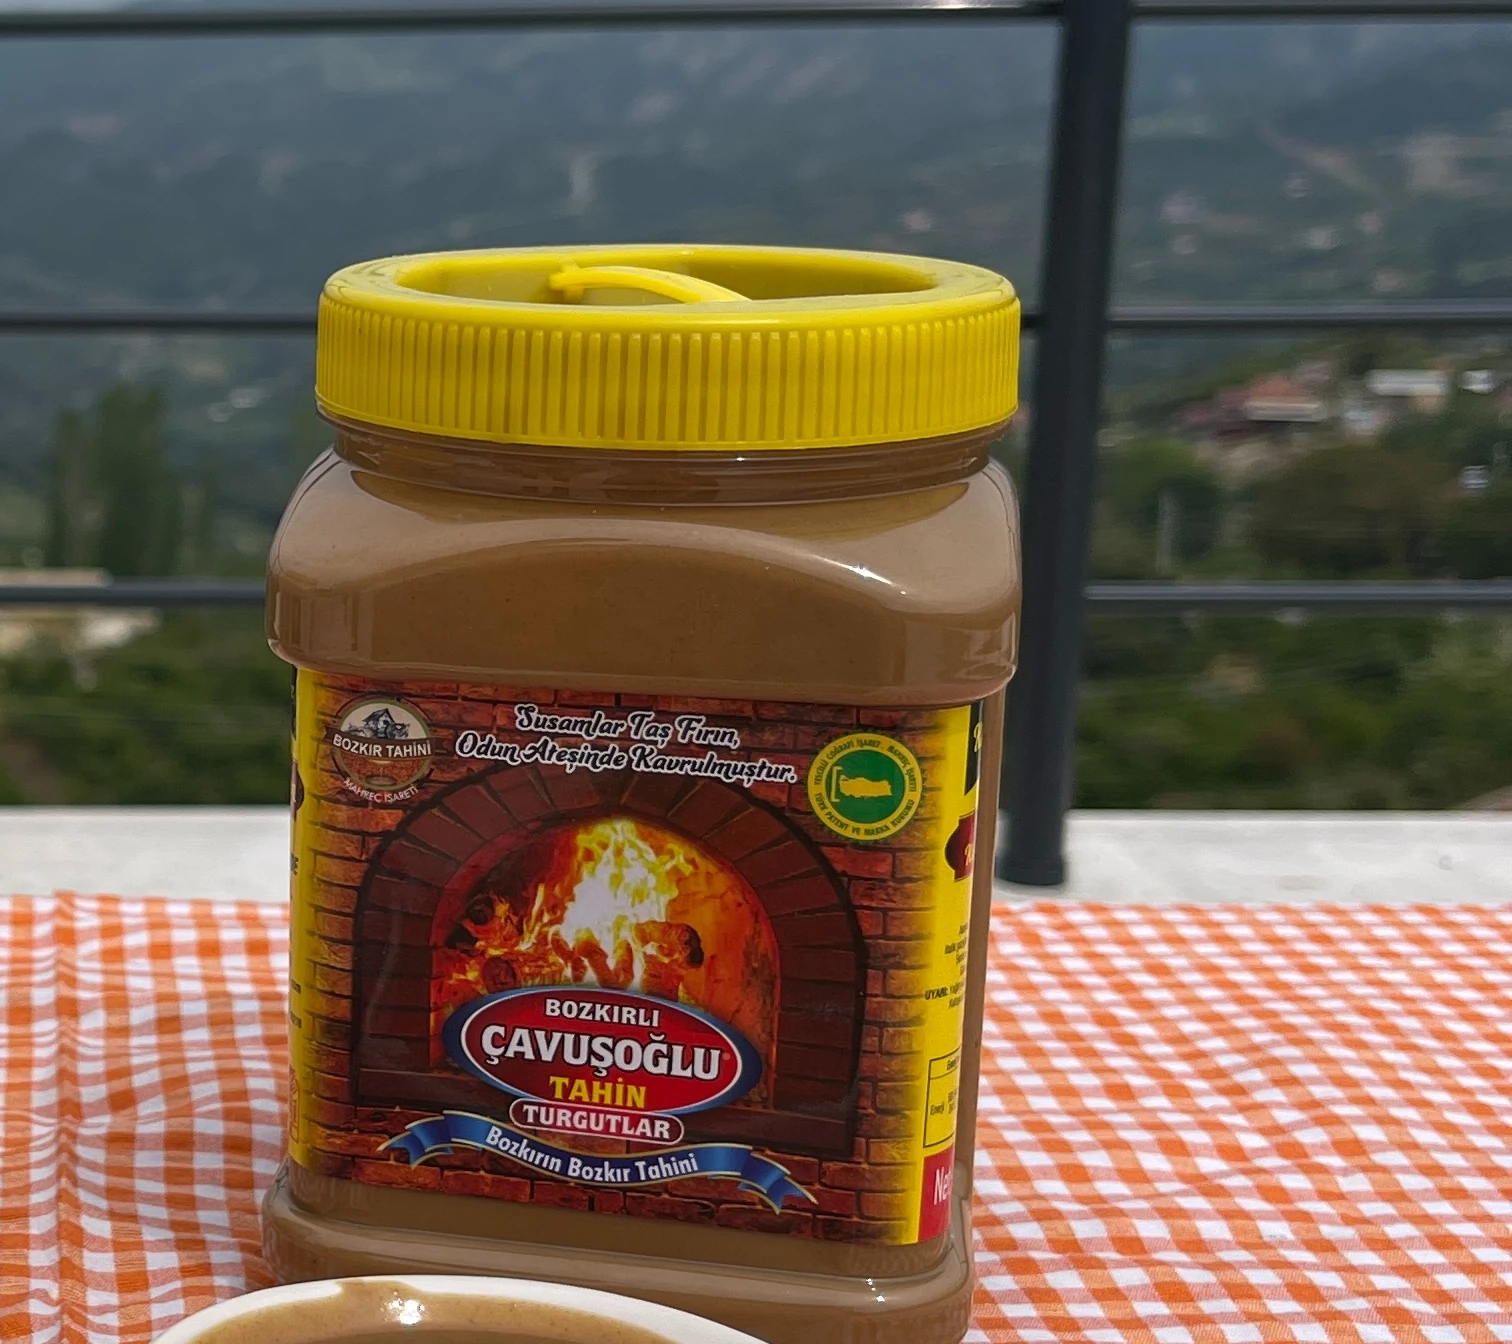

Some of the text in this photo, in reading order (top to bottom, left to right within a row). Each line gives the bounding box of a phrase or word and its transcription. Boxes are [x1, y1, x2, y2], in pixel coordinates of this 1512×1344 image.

[332, 734, 431, 758] BOZKIR TAHİNİ
[516, 704, 740, 749] Susamlar Taş Fırın,
[456, 731, 797, 787] Odun Ateşinde Kavrulmuştur.
[545, 998, 659, 1028] BOZKIRLI
[481, 1024, 721, 1081] ÇAVUŞOĞLU
[549, 1075, 647, 1109] TAHİN
[522, 1104, 672, 1140] TURGUTLAR
[484, 1125, 699, 1183] Bozkırın Bozkır Tahini
